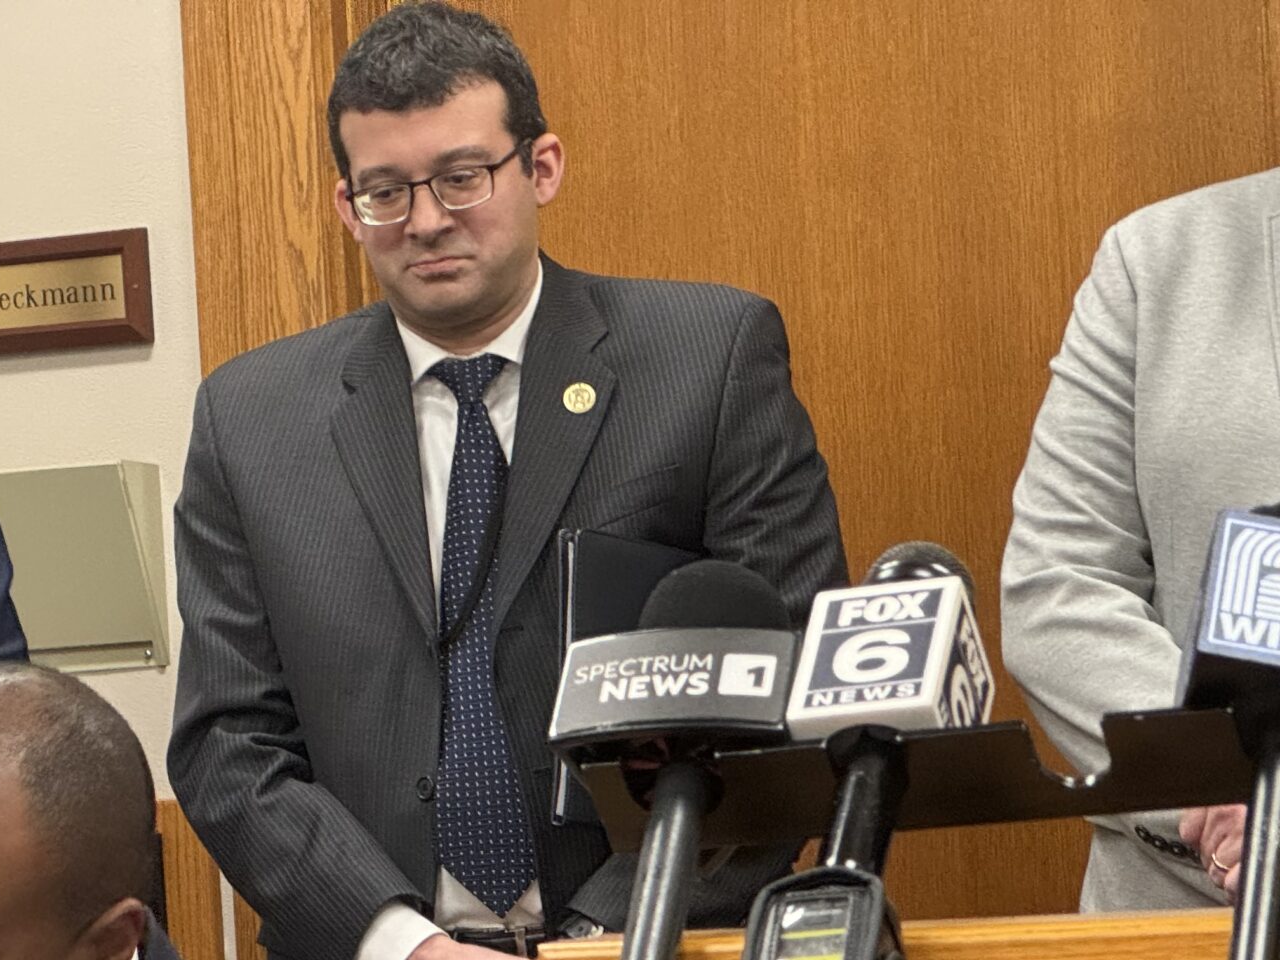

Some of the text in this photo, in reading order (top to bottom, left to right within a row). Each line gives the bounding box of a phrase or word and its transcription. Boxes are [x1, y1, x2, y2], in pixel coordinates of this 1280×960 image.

[837, 591, 930, 628] FOX
[574, 653, 714, 685] SPECTRUM
[832, 627, 912, 683] 6
[599, 666, 766, 704] NEWS 1
[811, 683, 916, 706] NEWS
